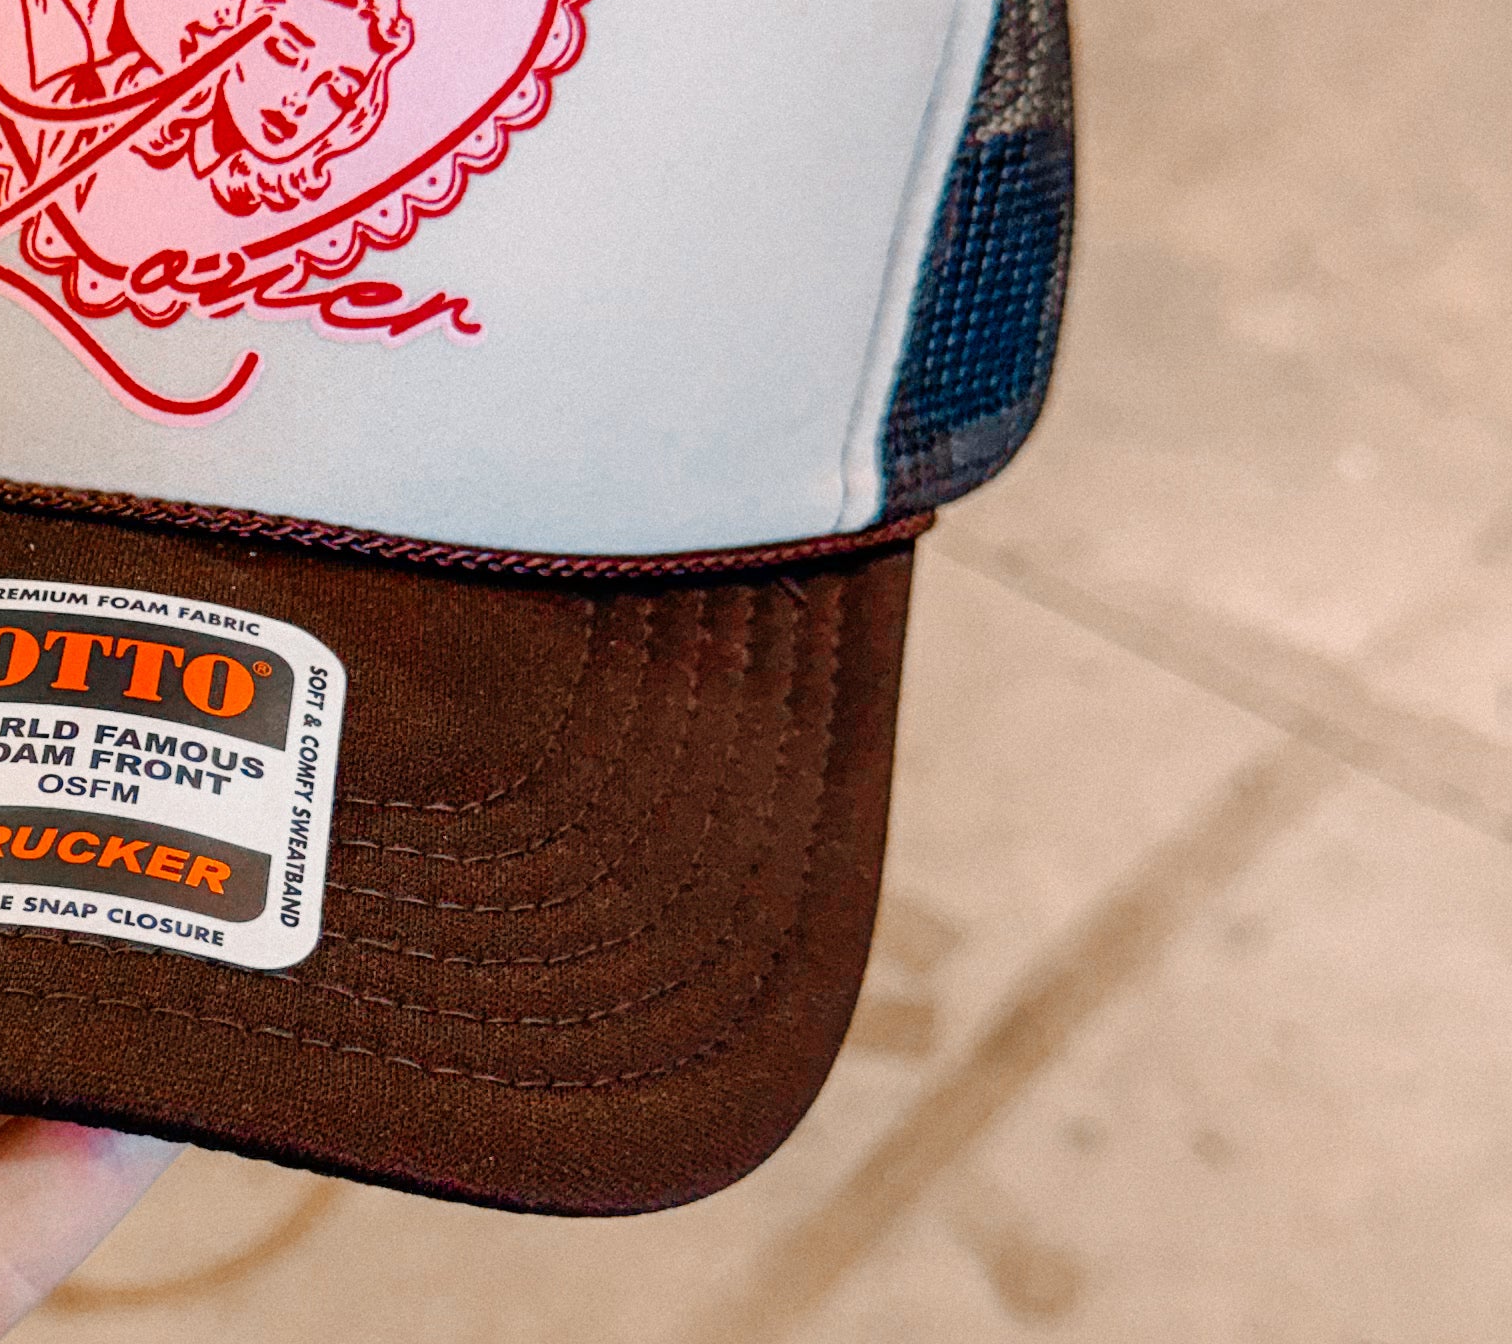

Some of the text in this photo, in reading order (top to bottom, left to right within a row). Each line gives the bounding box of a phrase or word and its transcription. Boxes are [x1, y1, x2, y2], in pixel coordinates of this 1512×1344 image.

[97, 595, 169, 616] FOAM
[177, 607, 261, 637] FABRIC
[89, 749, 232, 796] FRONT
[94, 724, 265, 780] FAMOUS
[37, 773, 140, 805] OSFM
[280, 665, 329, 929] SOFT & COMFY SWEATBAND
[21, 896, 98, 919] SNAP
[106, 908, 226, 947] CLOSURE
